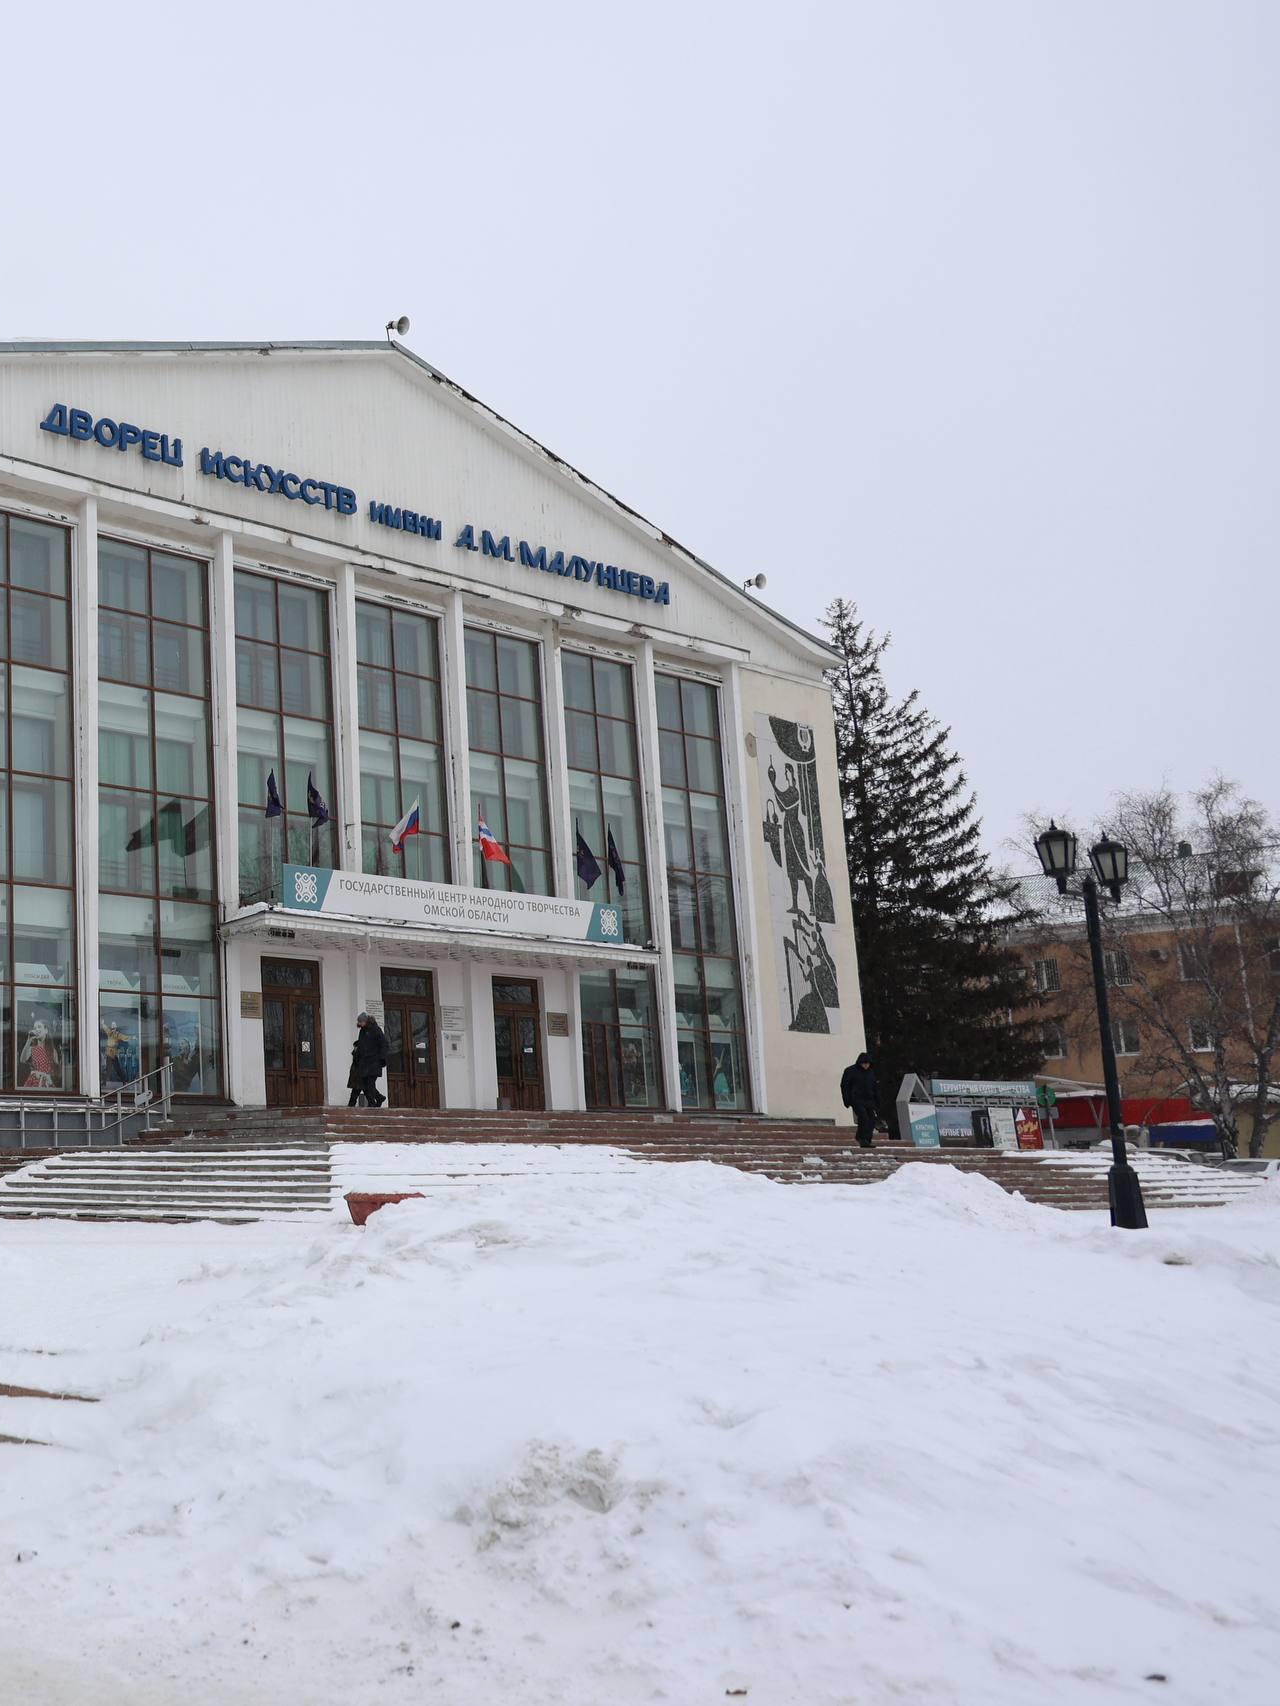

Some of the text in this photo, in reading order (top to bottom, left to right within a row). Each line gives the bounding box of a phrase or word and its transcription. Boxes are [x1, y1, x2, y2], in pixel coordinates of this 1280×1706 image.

[40, 403, 183, 467] ДВОРЕЦ
[200, 447, 357, 515] ИСКУССТВ
[369, 500, 442, 540] ИМЕНИ
[340, 879, 580, 917] ГОСУДАРСТВЕННЫЙ ЦЕНТР НАРОДНОГО ТВОРЧЕСТВА
[424, 904, 509, 923] ОМСКОЙ ОБЛАСТИ
